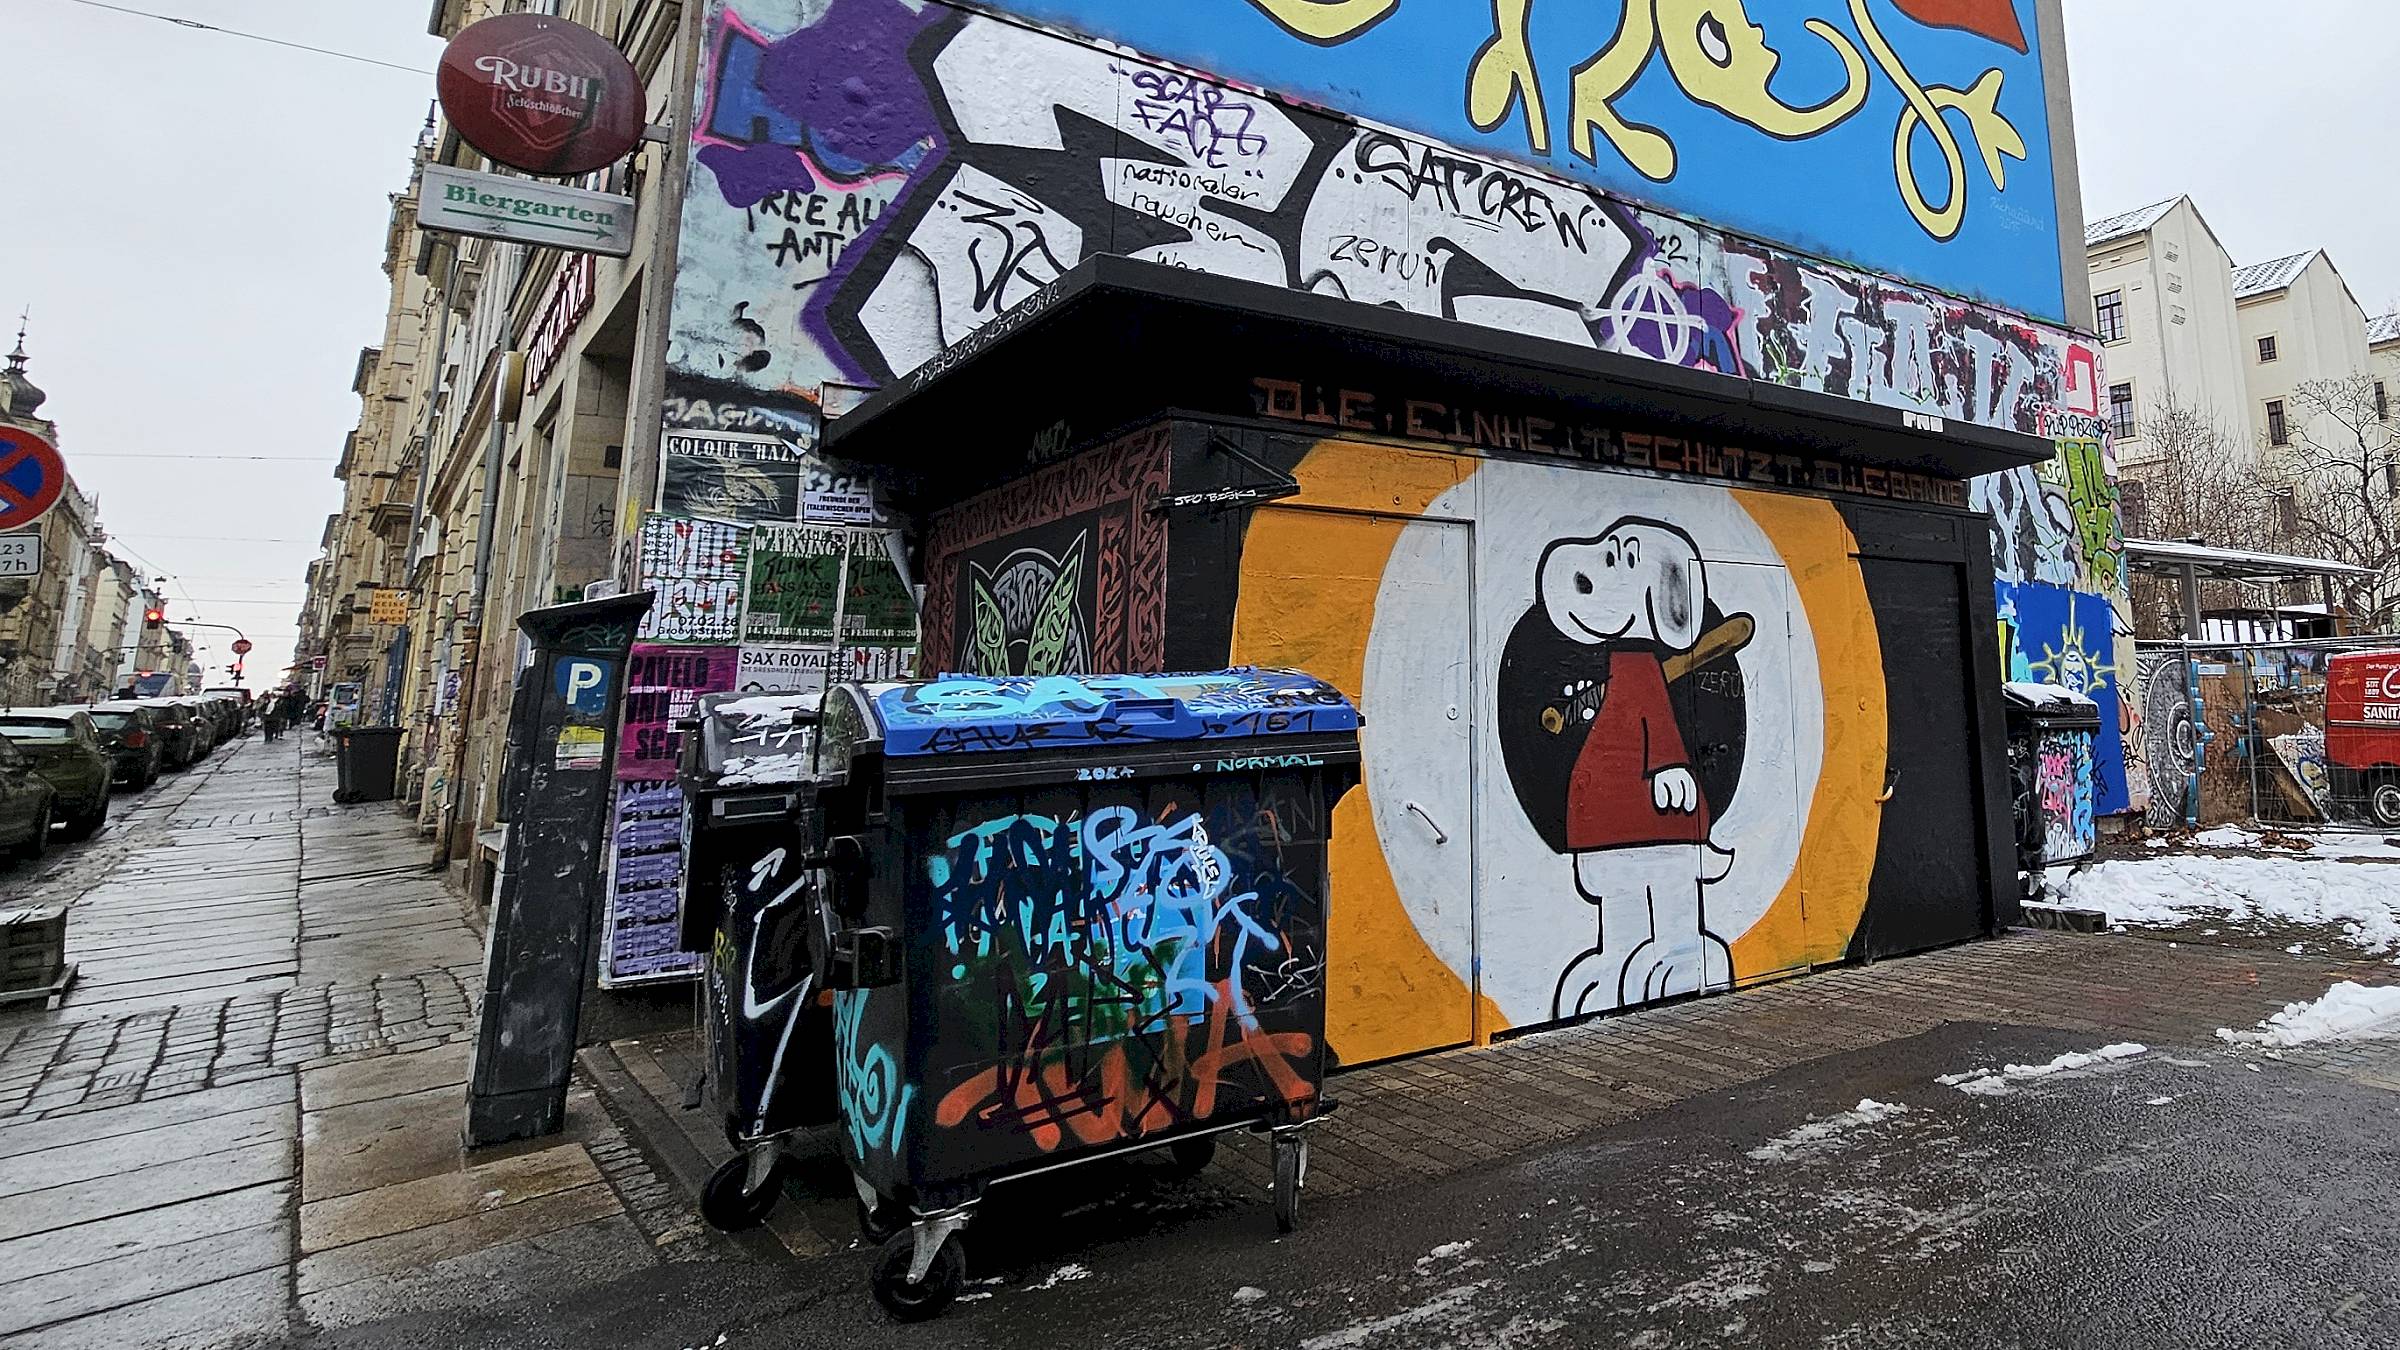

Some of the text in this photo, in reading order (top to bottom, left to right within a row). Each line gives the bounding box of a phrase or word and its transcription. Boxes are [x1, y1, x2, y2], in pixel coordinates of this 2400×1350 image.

[444, 183, 615, 226] Biergarten
[1478, 171, 1593, 253] CREW
[669, 436, 739, 459] COLOUR
[755, 536, 837, 556] WARNING
[741, 651, 829, 668] SAX ROYAL
[567, 662, 603, 705] P
[1216, 754, 1324, 773] NORMAL
